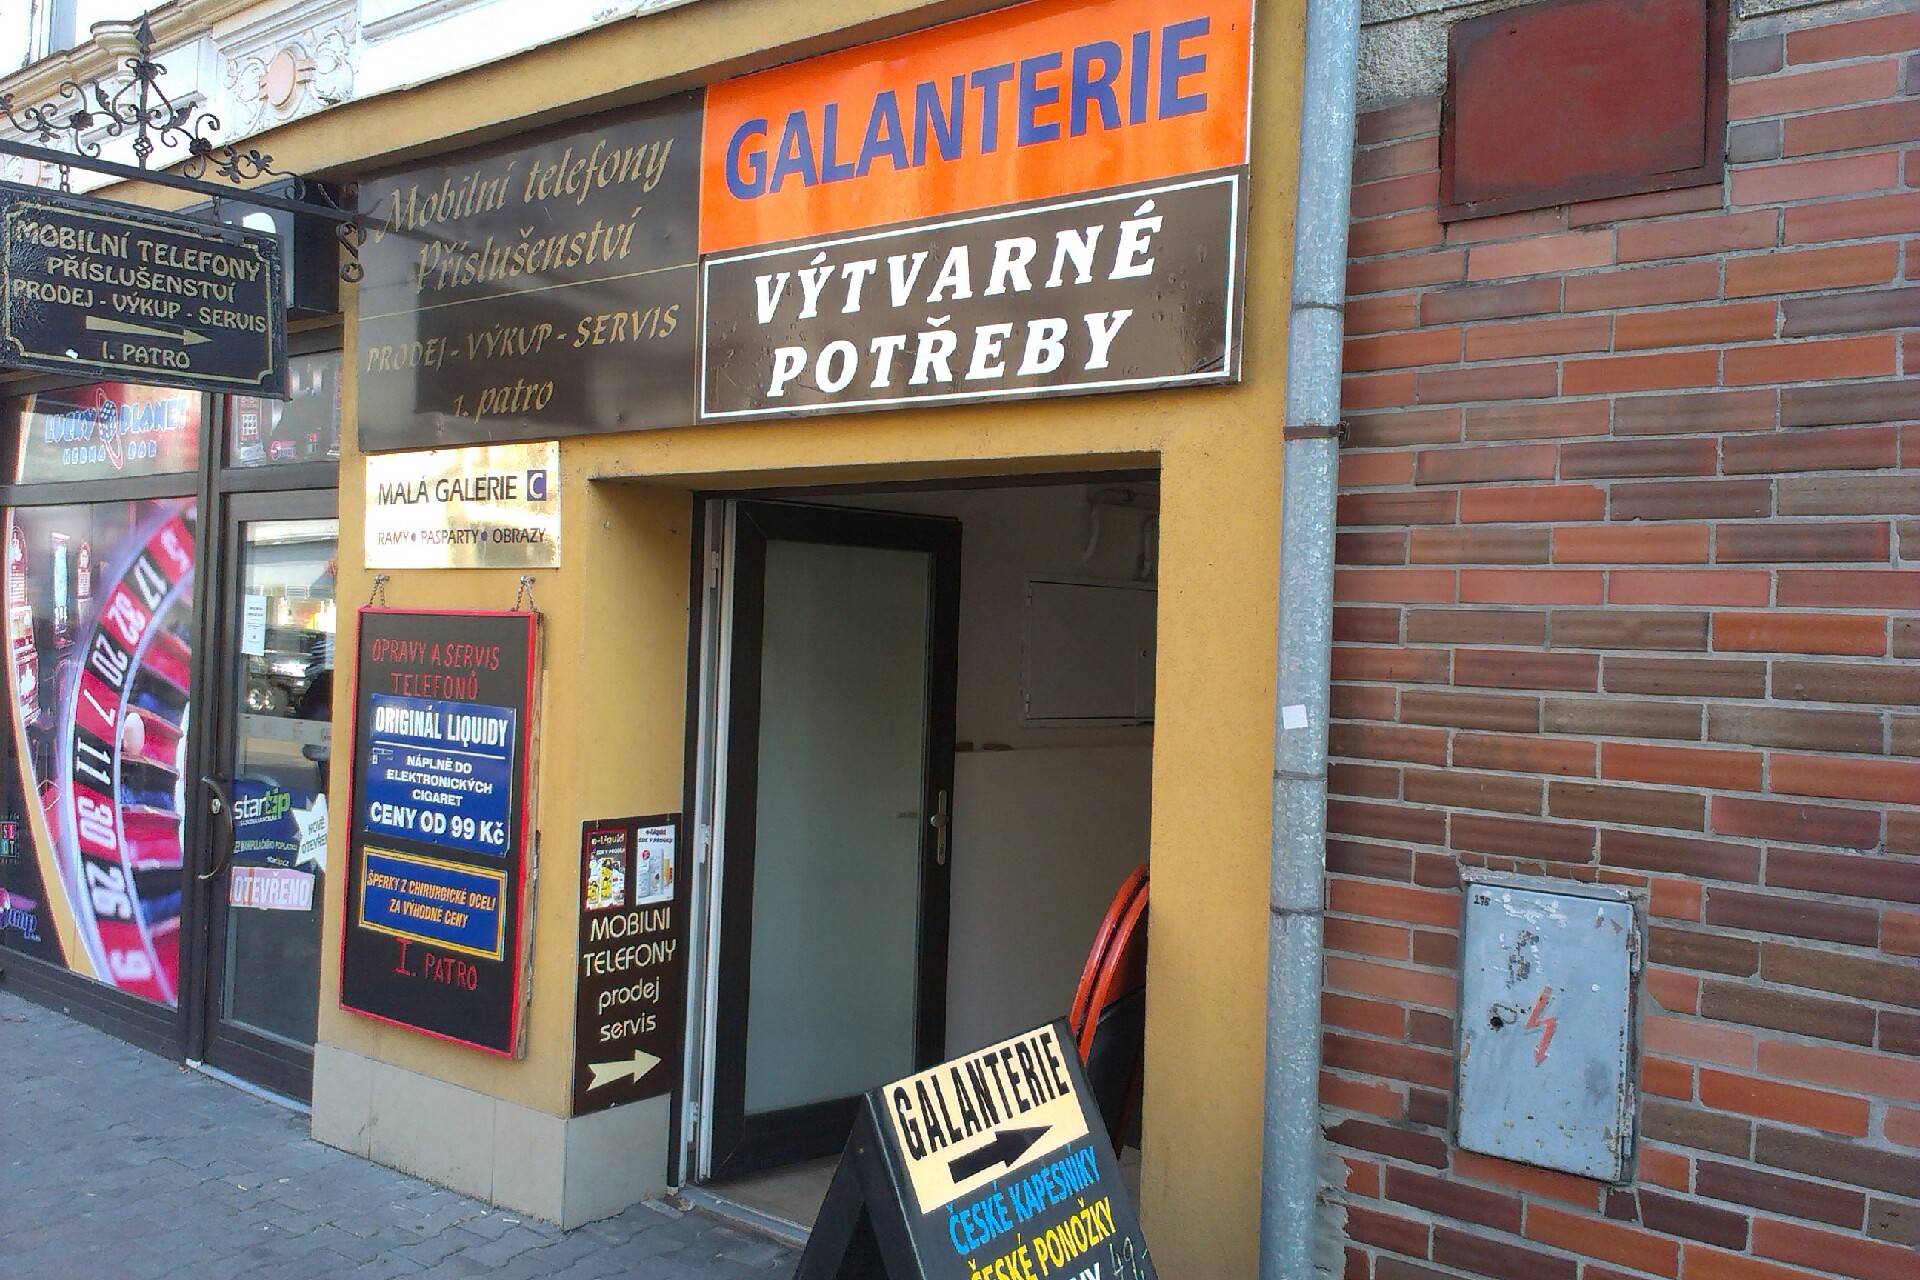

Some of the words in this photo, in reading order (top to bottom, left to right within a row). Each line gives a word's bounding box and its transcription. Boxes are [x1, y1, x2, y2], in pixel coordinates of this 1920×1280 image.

[725, 17, 1210, 199] GALANTERIE
[375, 160, 517, 244] Mobilní
[523, 137, 675, 206] telefony
[15, 220, 130, 259] MOBILNÍ
[137, 240, 260, 282] TELEFONY
[416, 206, 643, 295] Příslušenství
[754, 199, 1163, 325] VÝTVARNÉ
[47, 255, 234, 303] PŘÍSLUŠENSTVÍ
[12, 278, 93, 308] PRODEJ
[112, 290, 181, 321] VÝKUP
[199, 307, 266, 332] SERVIS
[123, 344, 191, 369] PATRO
[367, 336, 448, 373] PRODEJ
[573, 304, 679, 348] SERVIS
[767, 309, 1133, 398] POTŘEBY
[474, 379, 554, 424] patro
[379, 475, 429, 505] MALÁ
[436, 476, 518, 502] GALERIE
[379, 532, 409, 545] RAMY
[421, 529, 478, 545] PASPARTY
[493, 528, 546, 544] OBRAZY
[134, 555, 168, 611] 17
[107, 592, 146, 645] 32
[92, 632, 128, 687] 20
[371, 638, 426, 664] OPRAVY
[430, 645, 441, 666] A
[443, 643, 500, 671] SERVIS
[390, 671, 478, 700] TELEFONŮ
[84, 689, 116, 727] 7
[375, 705, 442, 740] ORIGINÁL
[448, 713, 509, 748] LIQUIDY
[76, 736, 111, 785] 11
[386, 769, 493, 795] ELEKTRONICKÝCH
[407, 753, 454, 772] NÁPLNĚ
[455, 761, 473, 774] DO
[412, 789, 463, 807] CIGARET
[78, 796, 117, 849] 30
[370, 801, 418, 829] CENY
[420, 811, 447, 834] OD
[450, 815, 476, 840] 99
[480, 820, 504, 845] Kč
[234, 872, 309, 907] OTEVŘENO
[367, 869, 399, 891] ŠPERKY
[400, 879, 408, 893] Z
[408, 881, 467, 905] CHIRURGICKÉ
[469, 892, 496, 912] OCELI
[389, 898, 400, 914] ZA
[403, 899, 443, 922] VÝHODNÉ
[444, 910, 469, 928] CENY
[425, 952, 478, 991] PATRO
[583, 939, 677, 977] TELEFONY
[599, 976, 660, 1016] prodej
[600, 1012, 656, 1042] servis
[892, 1032, 1070, 1162] GALANTERIE
[946, 1180, 1013, 1255] ČESKÉ
[1008, 1144, 1100, 1223] KAPESNÍKY
[1032, 1196, 1116, 1277] PONOŽKY
